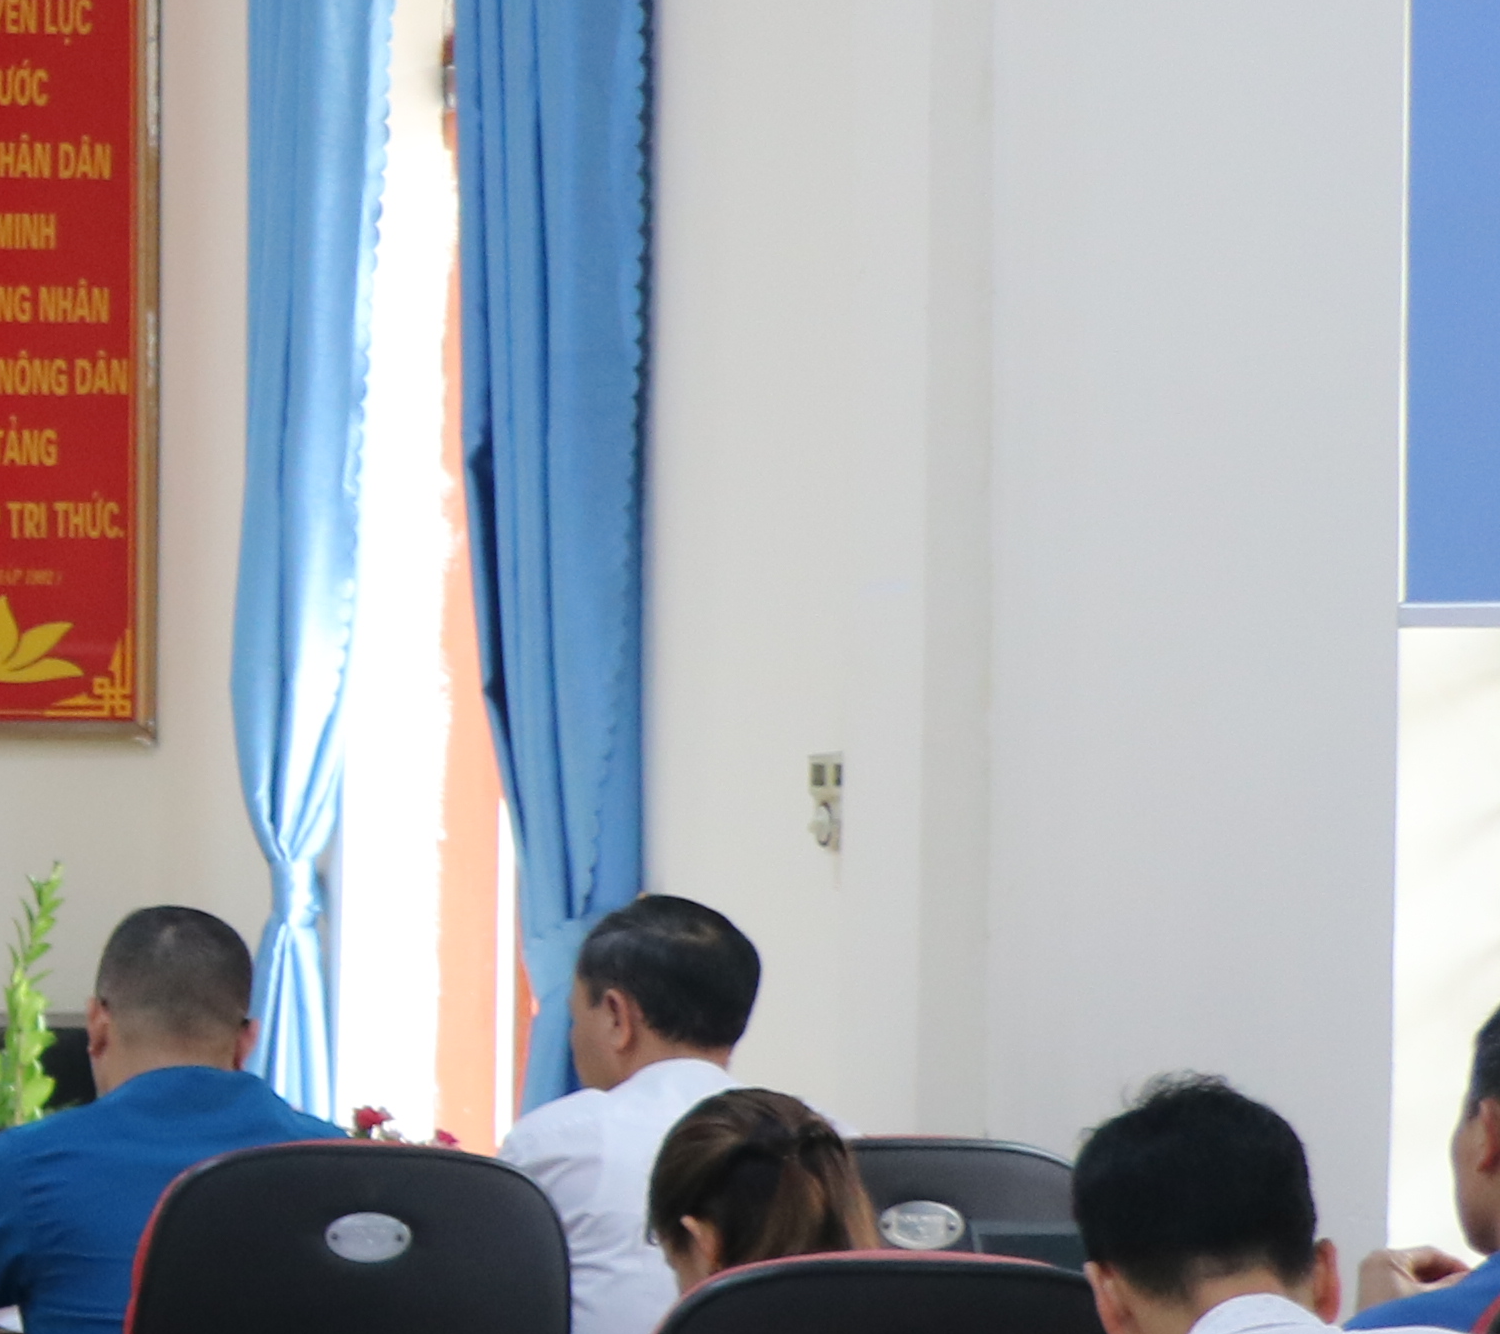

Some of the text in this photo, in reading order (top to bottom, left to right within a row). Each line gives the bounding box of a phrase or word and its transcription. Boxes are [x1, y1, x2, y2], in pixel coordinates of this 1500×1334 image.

[58, 135, 112, 181] DÂN
[39, 278, 110, 324] NHÂN
[75, 350, 129, 396] DÂN
[6, 501, 48, 539] TRI
[54, 492, 124, 539] THỨC.
